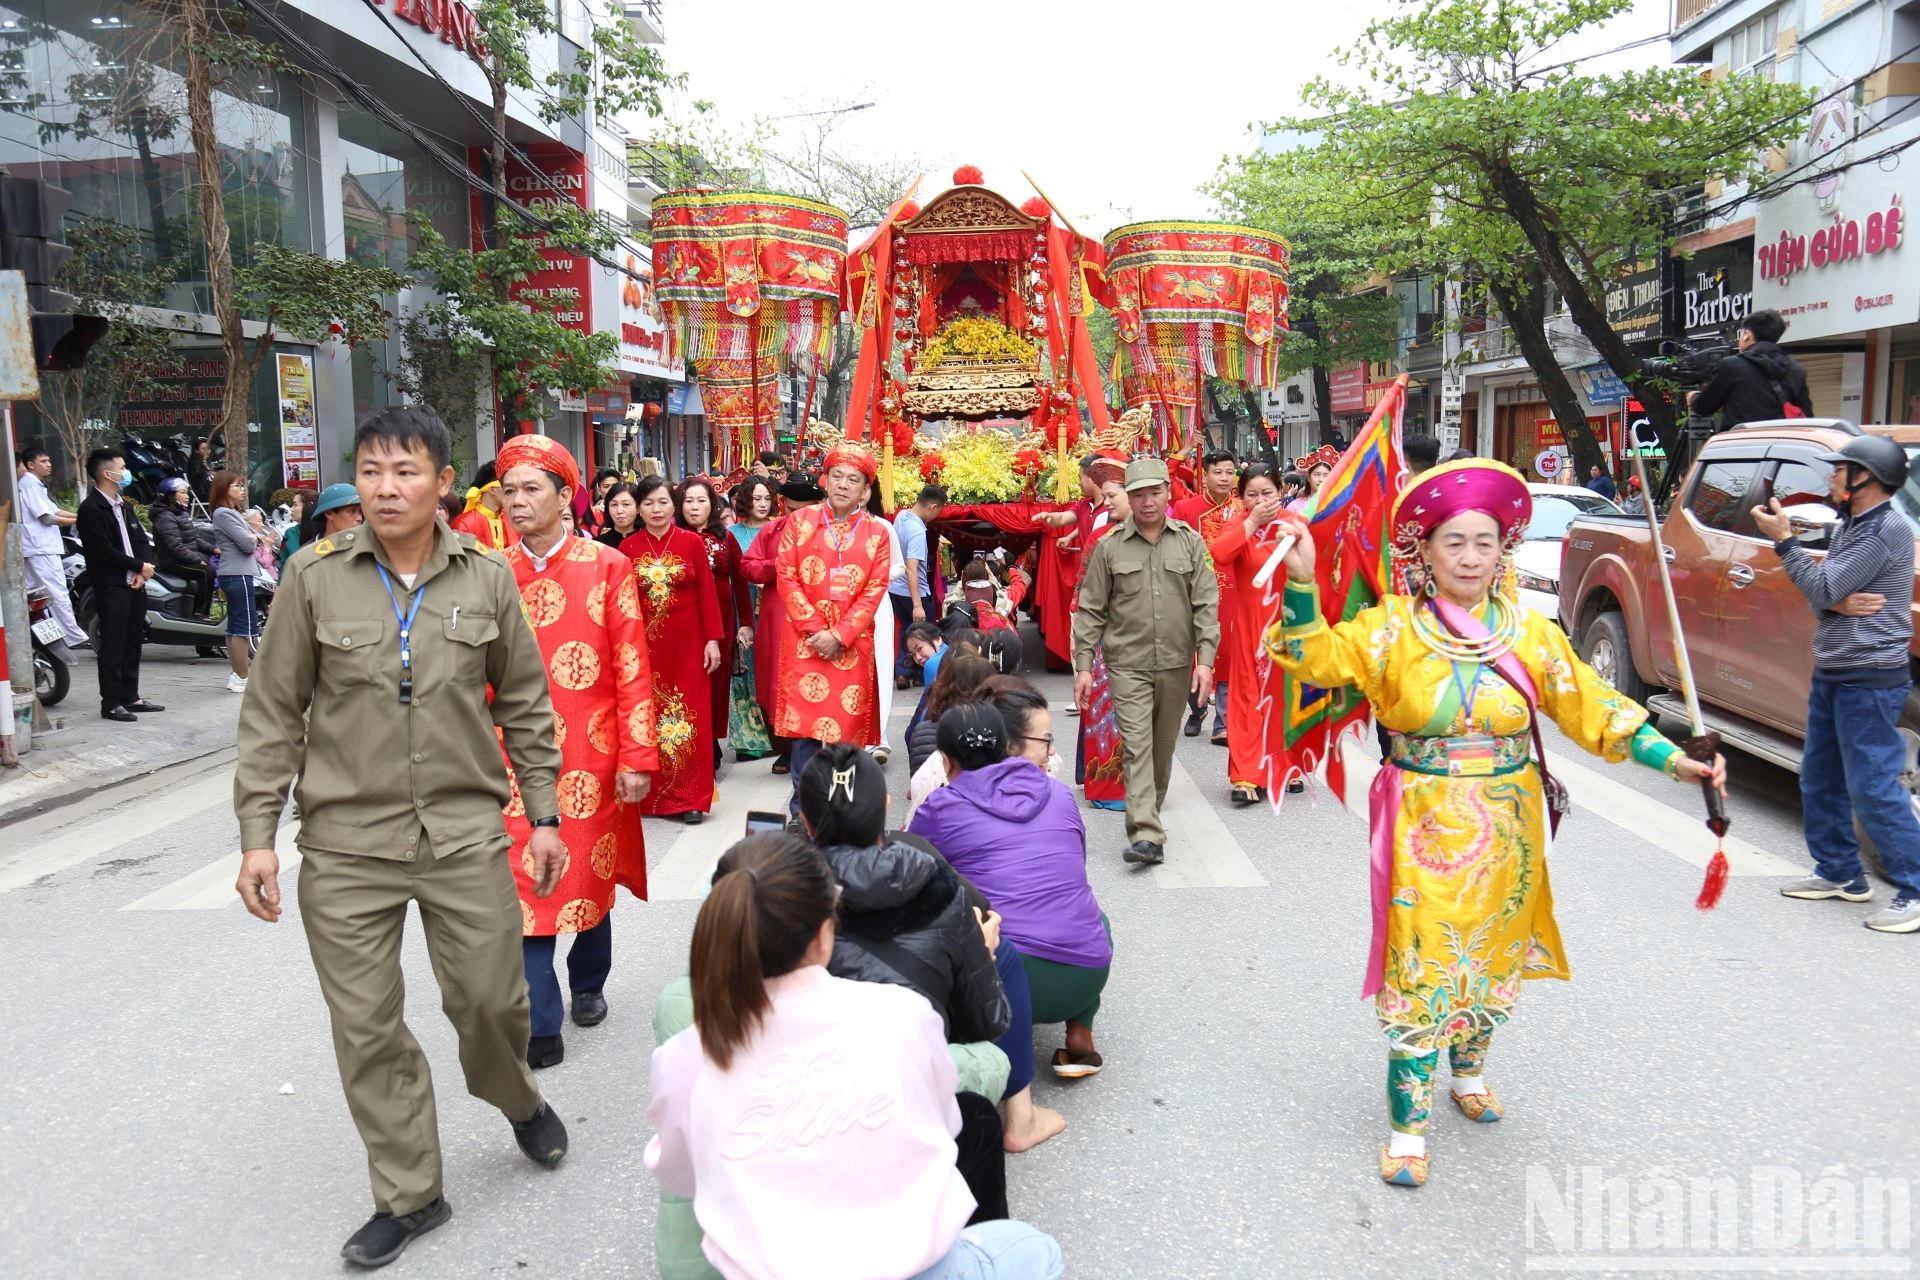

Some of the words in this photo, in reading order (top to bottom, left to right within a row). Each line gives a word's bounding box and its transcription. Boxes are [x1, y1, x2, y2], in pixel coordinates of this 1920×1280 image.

[510, 168, 583, 191] CHIẾN
[1759, 230, 1807, 286] TIỆM
[1811, 212, 1860, 268] CỦA
[1865, 193, 1903, 254] BÉ
[1697, 271, 1714, 292] The
[1684, 281, 1752, 329] Barber
